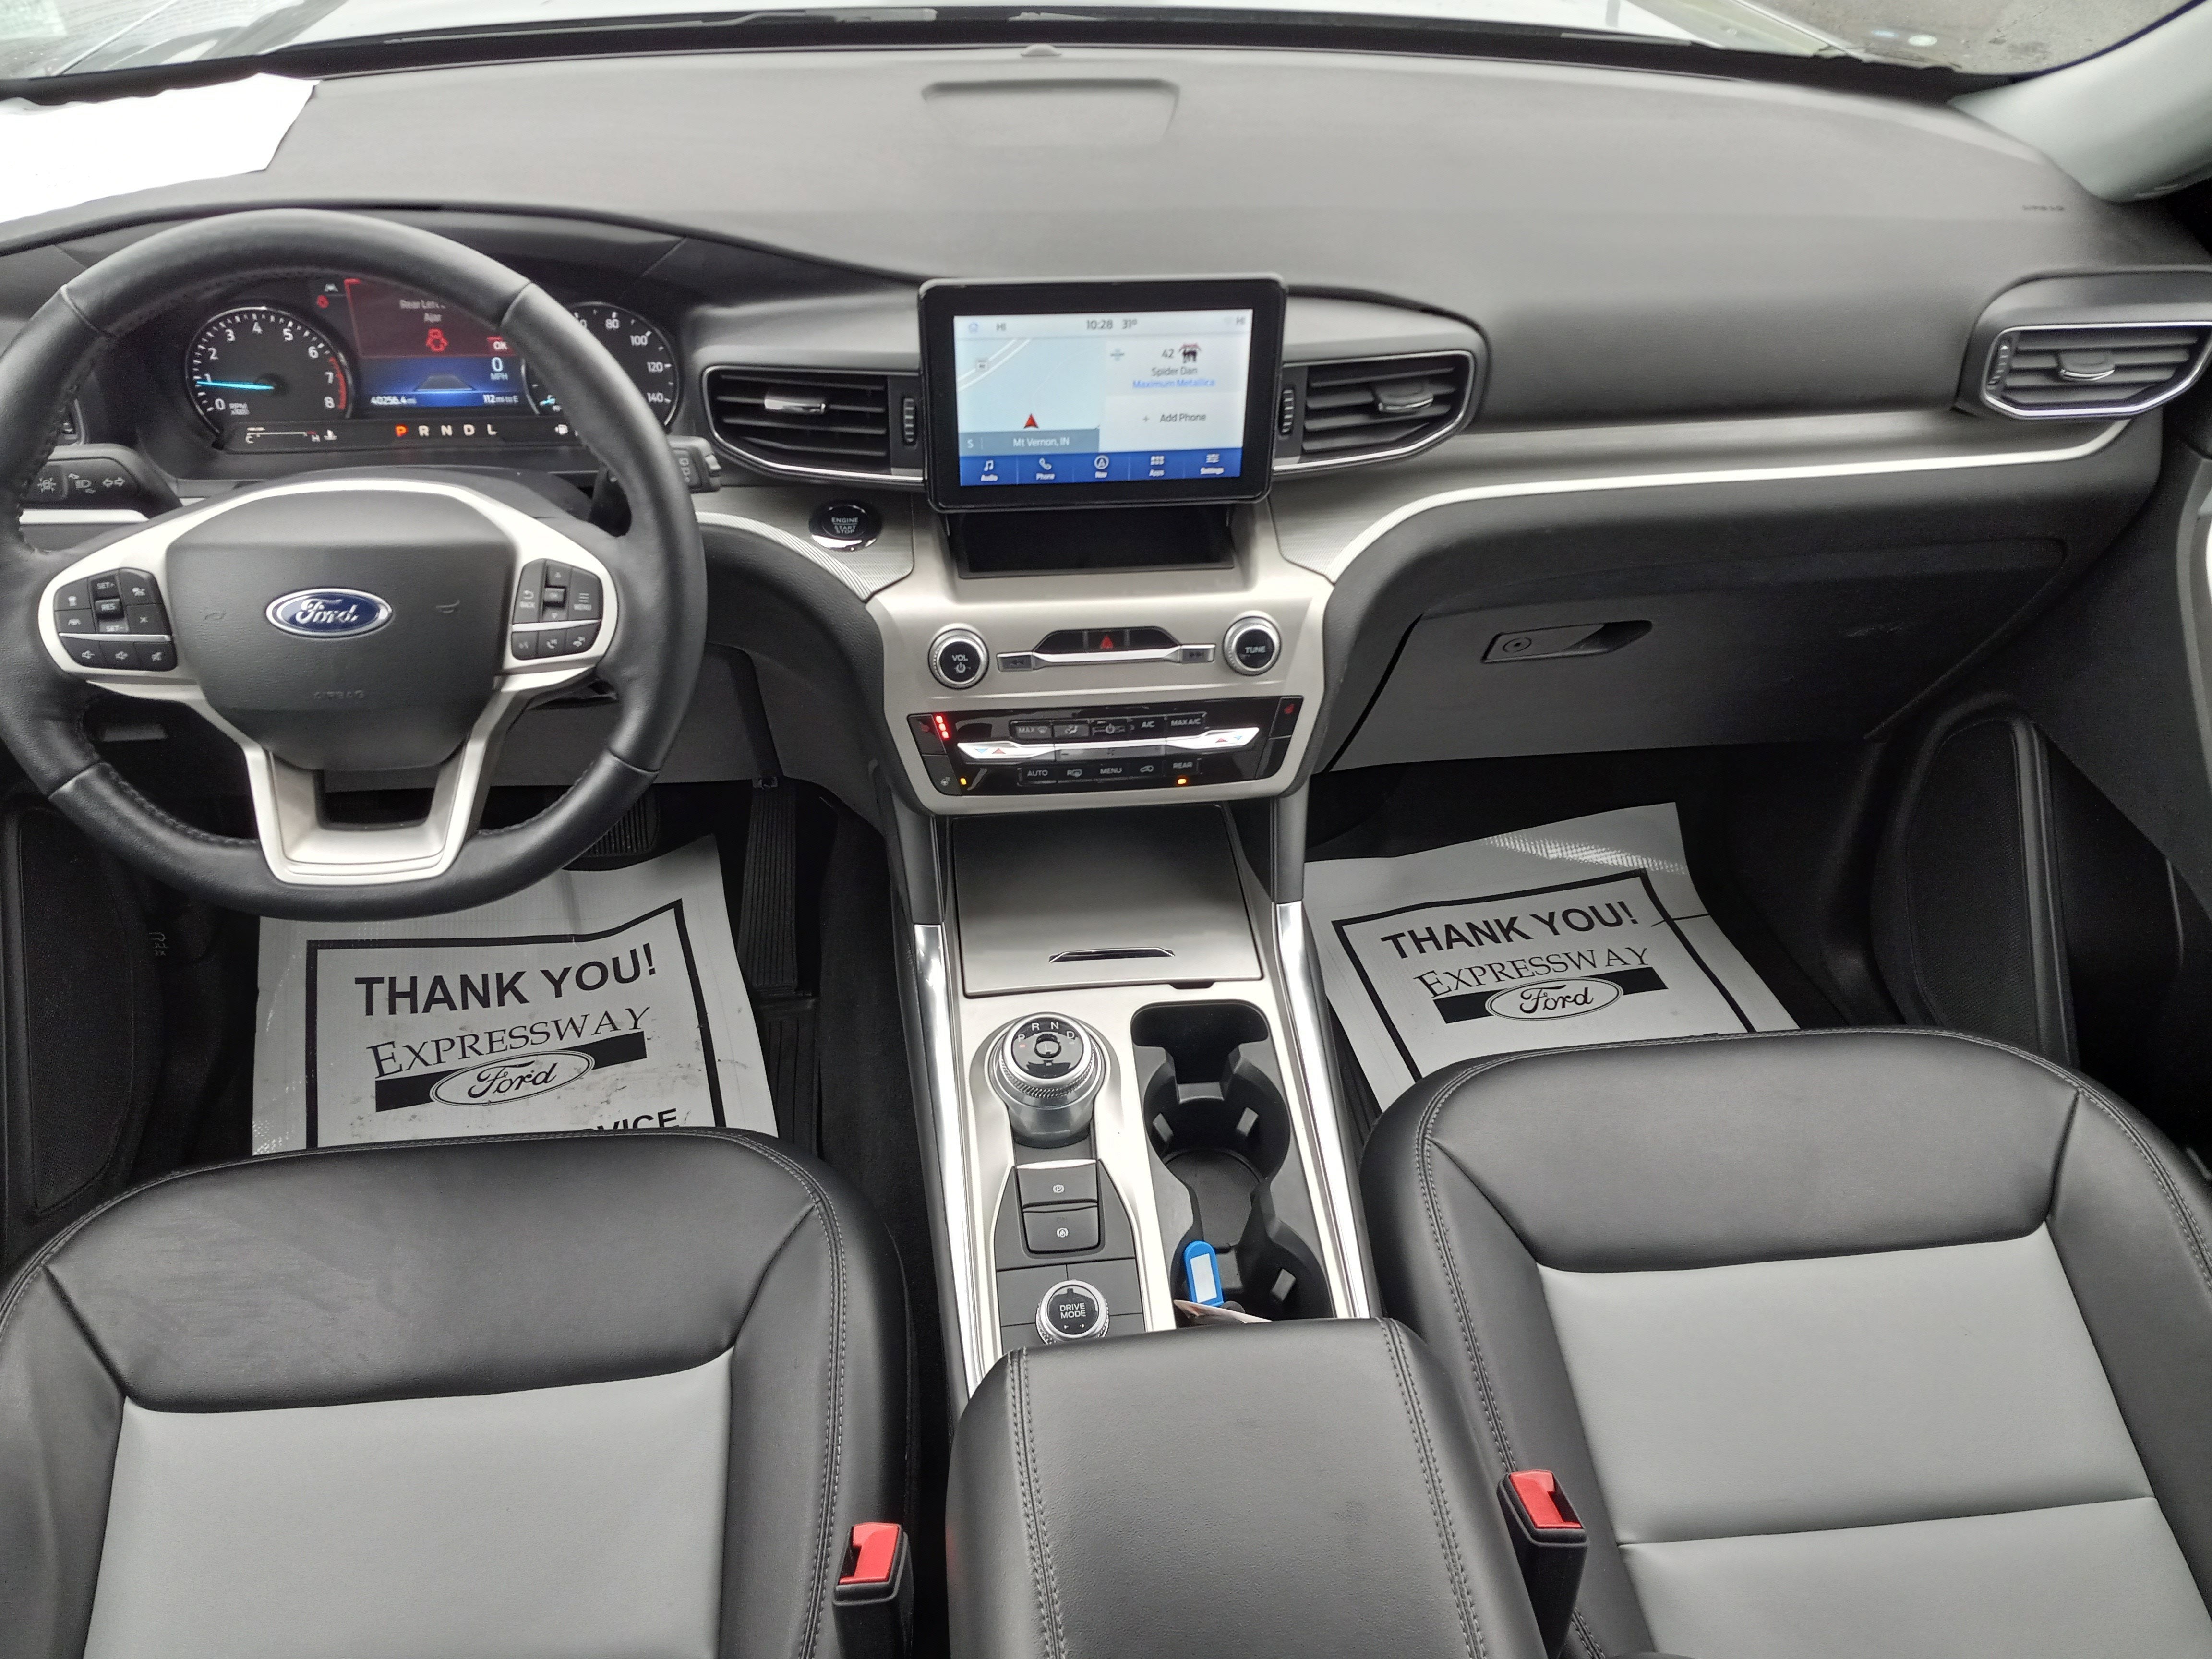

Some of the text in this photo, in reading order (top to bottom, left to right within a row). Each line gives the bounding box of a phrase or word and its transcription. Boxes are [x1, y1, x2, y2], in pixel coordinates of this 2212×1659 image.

[252, 321, 262, 334] 4
[605, 319, 619, 329] 80
[1086, 319, 1113, 330] 10:28
[225, 329, 236, 342] 3
[283, 328, 293, 341] 5
[630, 335, 648, 346] 100
[493, 341, 508, 350] OK
[208, 347, 218, 360] 2
[308, 346, 318, 359] 6
[1161, 349, 1175, 359] 42
[491, 357, 503, 372] 0
[646, 361, 663, 373] 120
[325, 371, 334, 383] 7
[1151, 366, 1198, 376] Spider Dan
[1133, 380, 1176, 388] Maximum
[215, 398, 226, 410] 0
[324, 396, 335, 409] 8
[647, 393, 664, 403] 140
[1159, 413, 1207, 423] Add Phone
[395, 423, 497, 437] P R N D L
[1013, 438, 1025, 447] Mt
[1060, 437, 1070, 446] IN
[294, 598, 359, 625] Ford
[1244, 645, 1266, 654] TUNE
[951, 654, 969, 662] VOL
[1141, 721, 1155, 729] A/C
[1173, 761, 1193, 769] REAR
[1027, 769, 1049, 777] AUTO
[1381, 900, 1638, 959] THANK YOU!
[1413, 946, 1648, 998] EXPRESSWAY
[355, 942, 657, 1017] THANK YOU!
[1518, 983, 1594, 1015] Ford
[1018, 1021, 1075, 1042] P R N D
[367, 1006, 650, 1080] EXPRESSWAY
[467, 1060, 559, 1099] Ford
[1059, 1302, 1086, 1312] DRIVE
[1060, 1310, 1086, 1319] MODE
